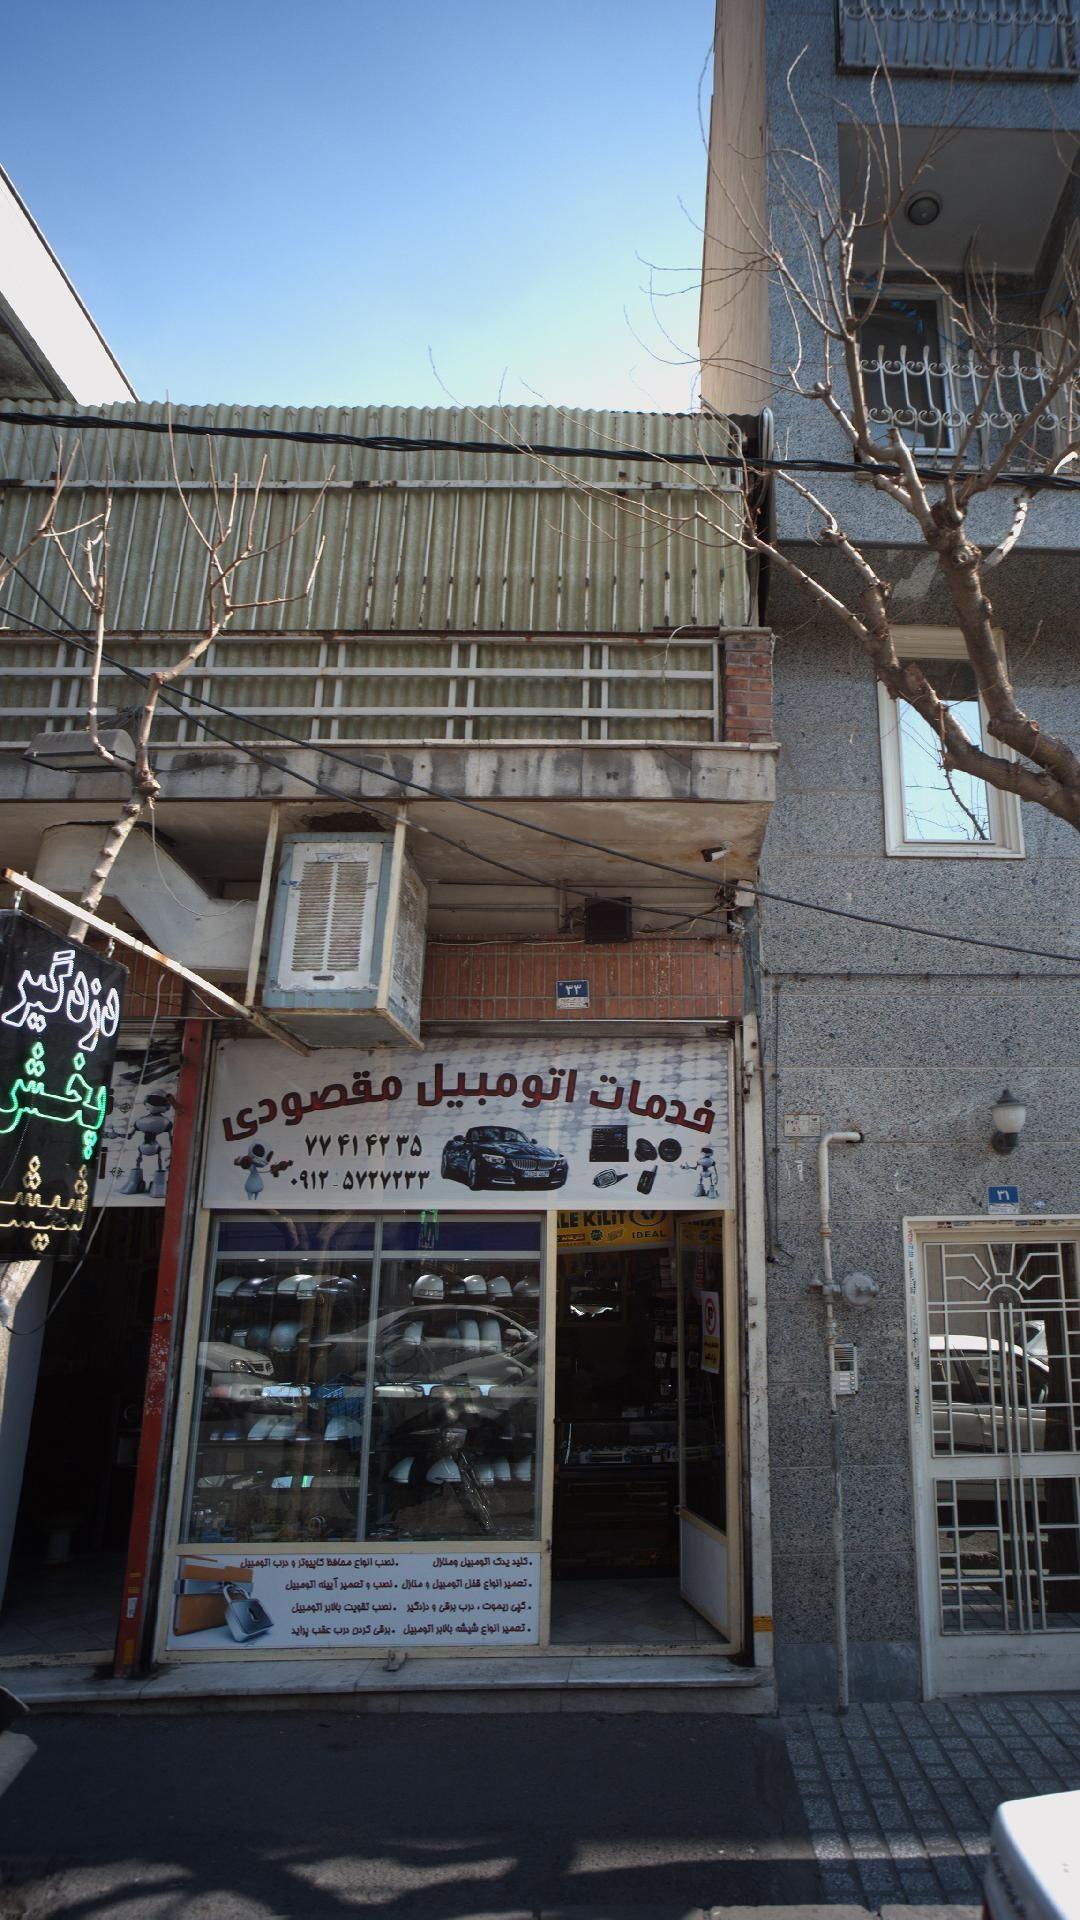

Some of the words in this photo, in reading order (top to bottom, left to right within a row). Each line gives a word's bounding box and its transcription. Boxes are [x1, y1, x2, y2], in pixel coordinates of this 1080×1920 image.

[1, 950, 120, 1051] دزدگیر
[417, 1063, 577, 1108] اتومبیل
[222, 1070, 402, 1142] مقصودی
[589, 1074, 716, 1134] خدمات
[632, 1230, 666, 1239] IDEAL
[240, 1558, 271, 1569] اتومبیل
[273, 1560, 289, 1568] درب
[327, 1557, 352, 1567] محافظ
[354, 1558, 372, 1568] انواع
[374, 1558, 395, 1567] نصب
[461, 1557, 490, 1567] اتومبیل
[493, 1557, 510, 1567] یدک
[512, 1557, 528, 1566] کلید
[285, 1579, 316, 1590] اتومبیل
[318, 1577, 339, 1589] آیینه
[340, 1579, 364, 1590] تعمیر
[373, 1580, 393, 1588] نصب
[402, 1579, 423, 1589] منازل
[432, 1579, 462, 1590] اتومبیل
[464, 1579, 481, 1589] قفل
[483, 1579, 502, 1590] انواع
[504, 1579, 527, 1589] تعمیر
[291, 1602, 322, 1613] اتومبیل
[324, 1602, 342, 1612] بالابر
[344, 1602, 370, 1613] تقویت
[372, 1603, 392, 1611] نصب
[406, 1602, 429, 1612] دزدگیر
[439, 1602, 456, 1612] برقی
[459, 1603, 474, 1612] درب
[511, 1601, 526, 1613] کپی
[291, 1625, 309, 1637] پراید
[312, 1625, 331, 1635] عقب
[333, 1626, 350, 1635] درب
[352, 1624, 371, 1635] کردن
[373, 1624, 391, 1635] برقی
[403, 1624, 433, 1635] اتومبیل
[436, 1624, 453, 1634] بالابر
[456, 1622, 479, 1633] شیشه
[481, 1623, 500, 1635] انواع
[502, 1623, 525, 1634] تعمیر
